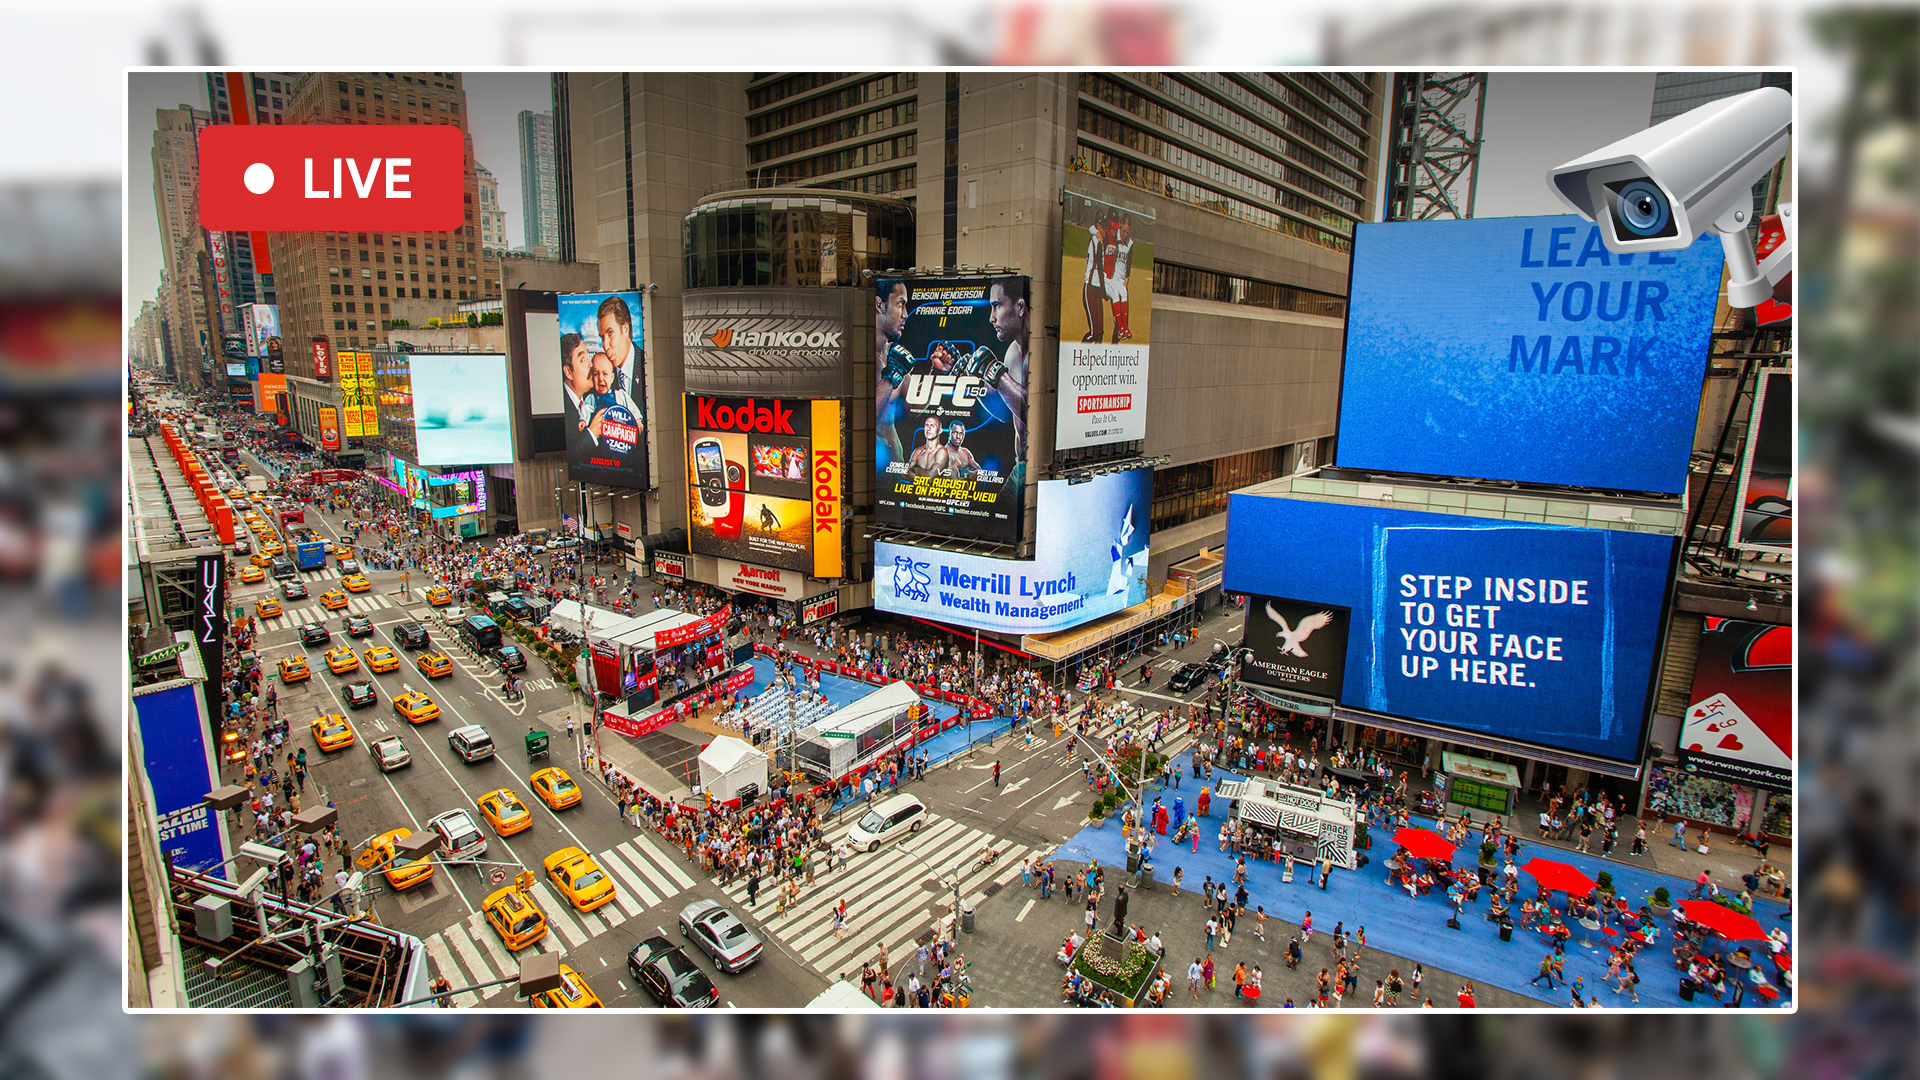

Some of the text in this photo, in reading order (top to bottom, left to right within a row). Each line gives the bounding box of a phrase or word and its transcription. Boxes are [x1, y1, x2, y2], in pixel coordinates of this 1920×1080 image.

[1520, 226, 1676, 268] LEA
[213, 241, 231, 313] YOUNG
[912, 290, 984, 300] BENSON HENDERSON
[1531, 280, 1669, 322] YOUR
[916, 306, 973, 315] FRANKIE EDGAR
[748, 348, 840, 357] driving emotion
[894, 344, 916, 363] UFC
[1072, 349, 1139, 370] Helped injured
[1508, 335, 1661, 376] MARK
[1072, 370, 1137, 390] opponent win.
[906, 374, 988, 408] UFC 150
[1079, 396, 1130, 412] SPORTSMANSHIP
[611, 410, 628, 422] WILL
[698, 397, 795, 434] Kodak
[1092, 414, 1118, 424] Pass It On.
[602, 424, 636, 444] CAMPAIGN
[1085, 430, 1108, 438] VALUES.COM
[609, 439, 628, 451] ZACH
[590, 458, 612, 466] AUGUST
[886, 466, 908, 474] CERRONE
[938, 468, 952, 476] VS
[976, 476, 1004, 484] GUILLARD
[815, 450, 838, 533] Kodak
[913, 476, 976, 491] SAT. AUGUST 11
[894, 482, 997, 503] LIVE ON PAY-PER-VIEW
[905, 502, 946, 512] facebook.com/UFC
[954, 508, 990, 518] twitter.com/ufc
[738, 564, 780, 582] Marriott
[760, 583, 786, 592] MARQUIS
[940, 565, 1076, 600] Merrill Lynch
[1400, 574, 1589, 604] STEP INSIDE
[802, 590, 838, 606] MARQUIS
[940, 592, 1084, 620] Wealth Management
[816, 602, 836, 618] EVITA
[1400, 602, 1501, 629] TO GET
[1400, 628, 1563, 661] YOUR FACE
[143, 644, 186, 664] LAMAR
[1252, 660, 1328, 680] AMERICAN EAGLE
[1266, 670, 1310, 682] OUTFITTERS
[1401, 654, 1536, 688] UP HERE.
[525, 676, 558, 692] ONLY
[648, 676, 656, 686] LG
[1256, 690, 1300, 710] OUTFITTERS
[1705, 699, 1726, 714] K
[1719, 719, 1738, 728] 9
[1287, 796, 1300, 804] HOT
[1300, 799, 1318, 809] DOGS
[160, 818, 209, 841] ST TIME
[1322, 822, 1348, 835] snack
[1336, 834, 1348, 850] BOX
